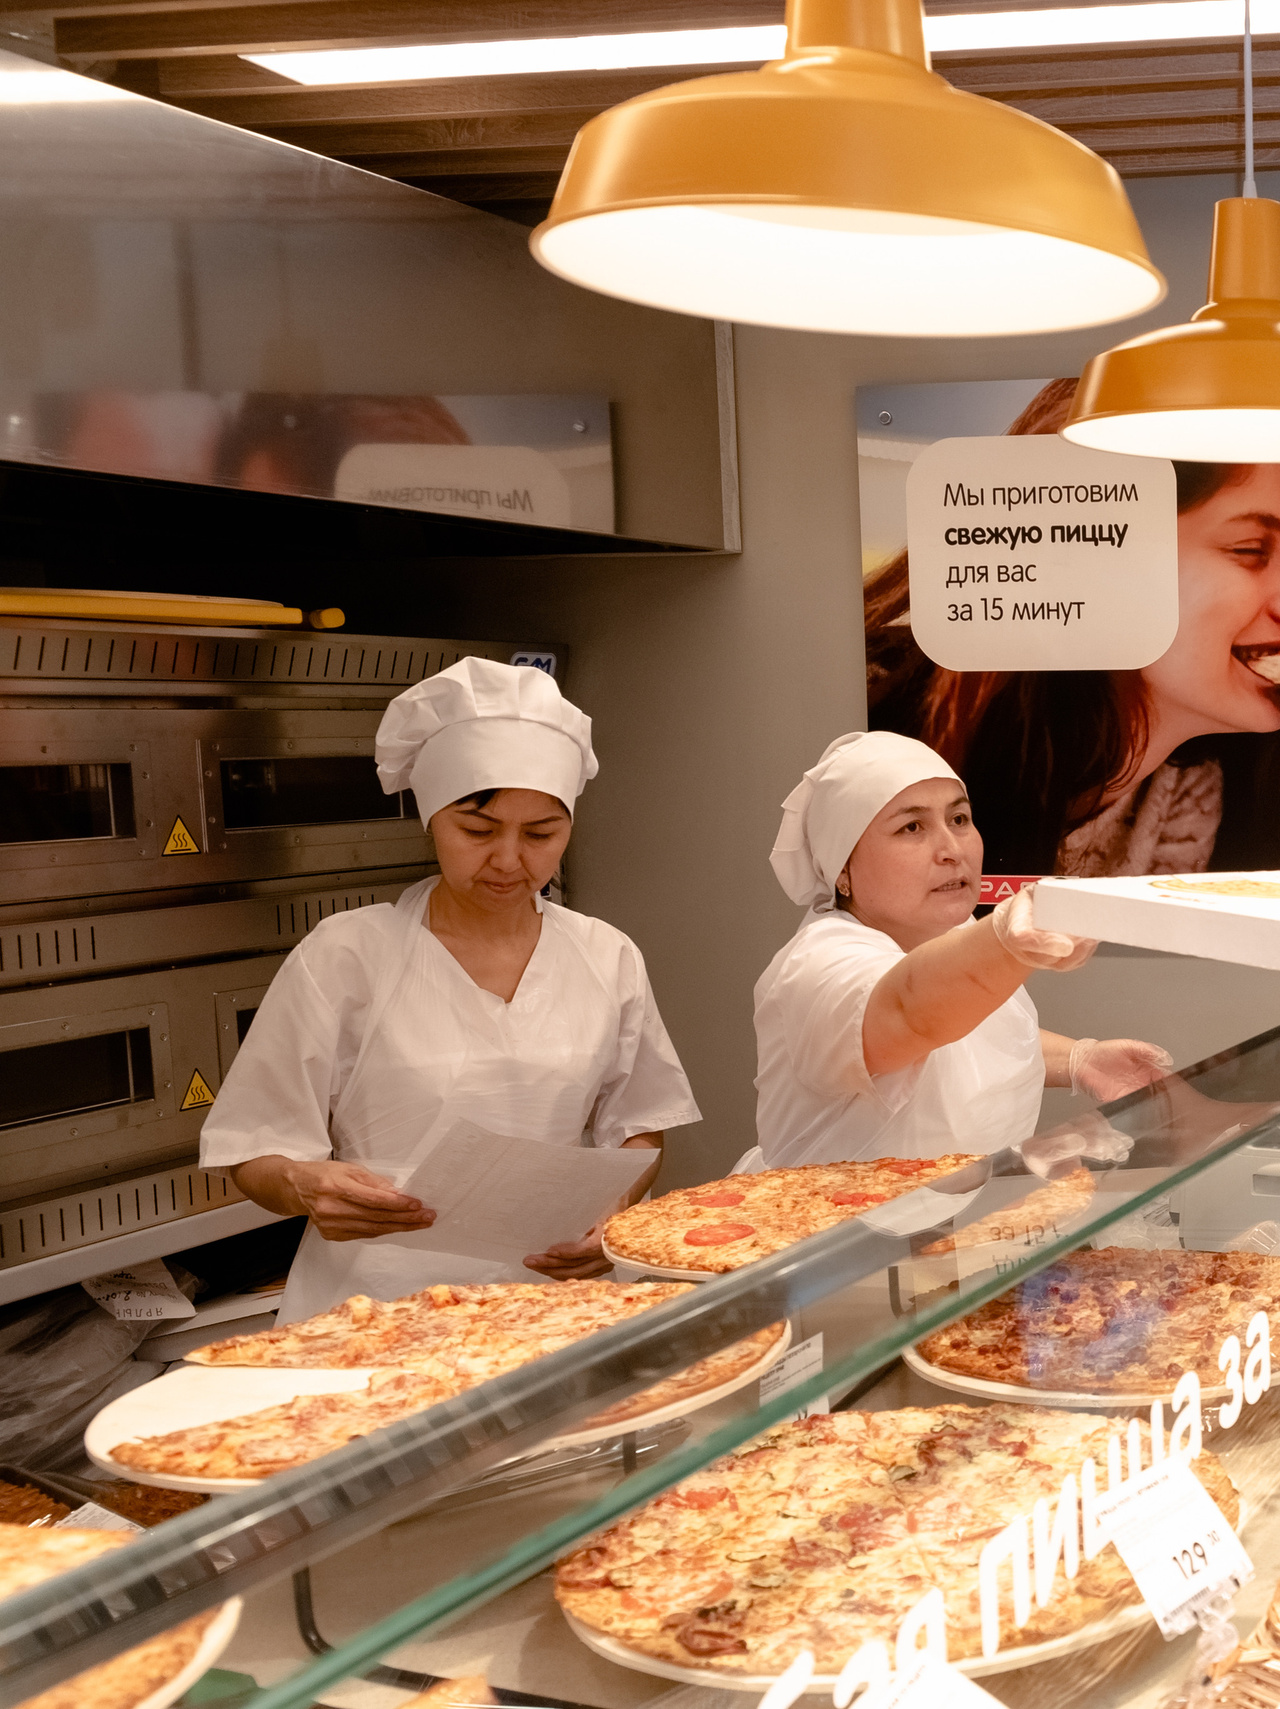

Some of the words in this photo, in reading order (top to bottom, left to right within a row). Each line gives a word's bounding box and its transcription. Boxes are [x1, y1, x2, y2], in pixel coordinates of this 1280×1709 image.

[944, 483, 984, 506] Мы
[993, 484, 1138, 511] приготовим
[945, 526, 1042, 550] свежую
[1051, 524, 1128, 548] пиццу
[946, 565, 988, 588] для
[997, 565, 1036, 582] вас
[948, 603, 972, 621] за
[981, 598, 1003, 620] 15
[1012, 602, 1085, 626] минут
[1172, 1541, 1209, 1580] 129
